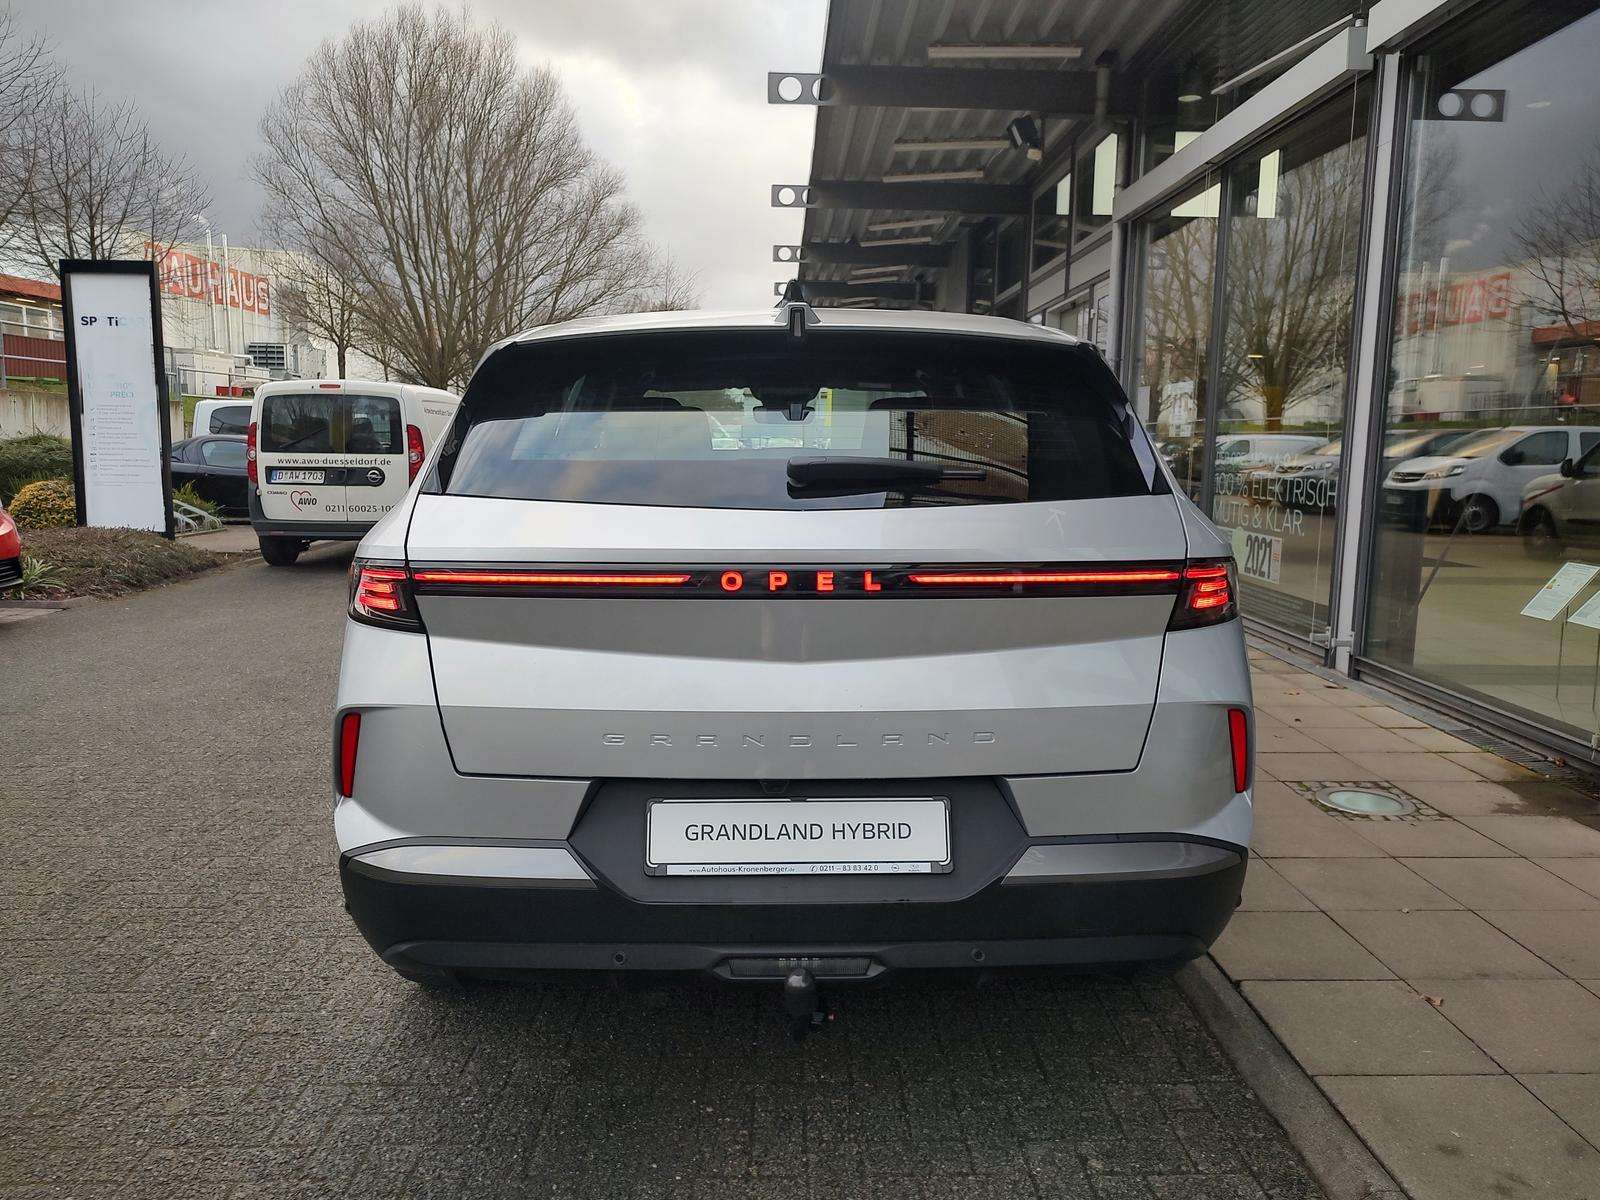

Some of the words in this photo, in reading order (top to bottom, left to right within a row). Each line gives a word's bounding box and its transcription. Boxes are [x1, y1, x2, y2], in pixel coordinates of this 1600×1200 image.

[1251, 472, 1338, 508] ELEKTRISCH
[298, 497, 318, 506] AWO
[348, 504, 397, 513] 60025-10
[1251, 504, 1263, 529] &
[1265, 506, 1305, 537] KLAR.
[1244, 534, 1273, 580] 2021
[720, 570, 882, 592] OPEL
[601, 730, 1001, 749] GRANDLAND
[684, 823, 824, 841] GRANDLAND
[831, 822, 913, 840] HYBRID
